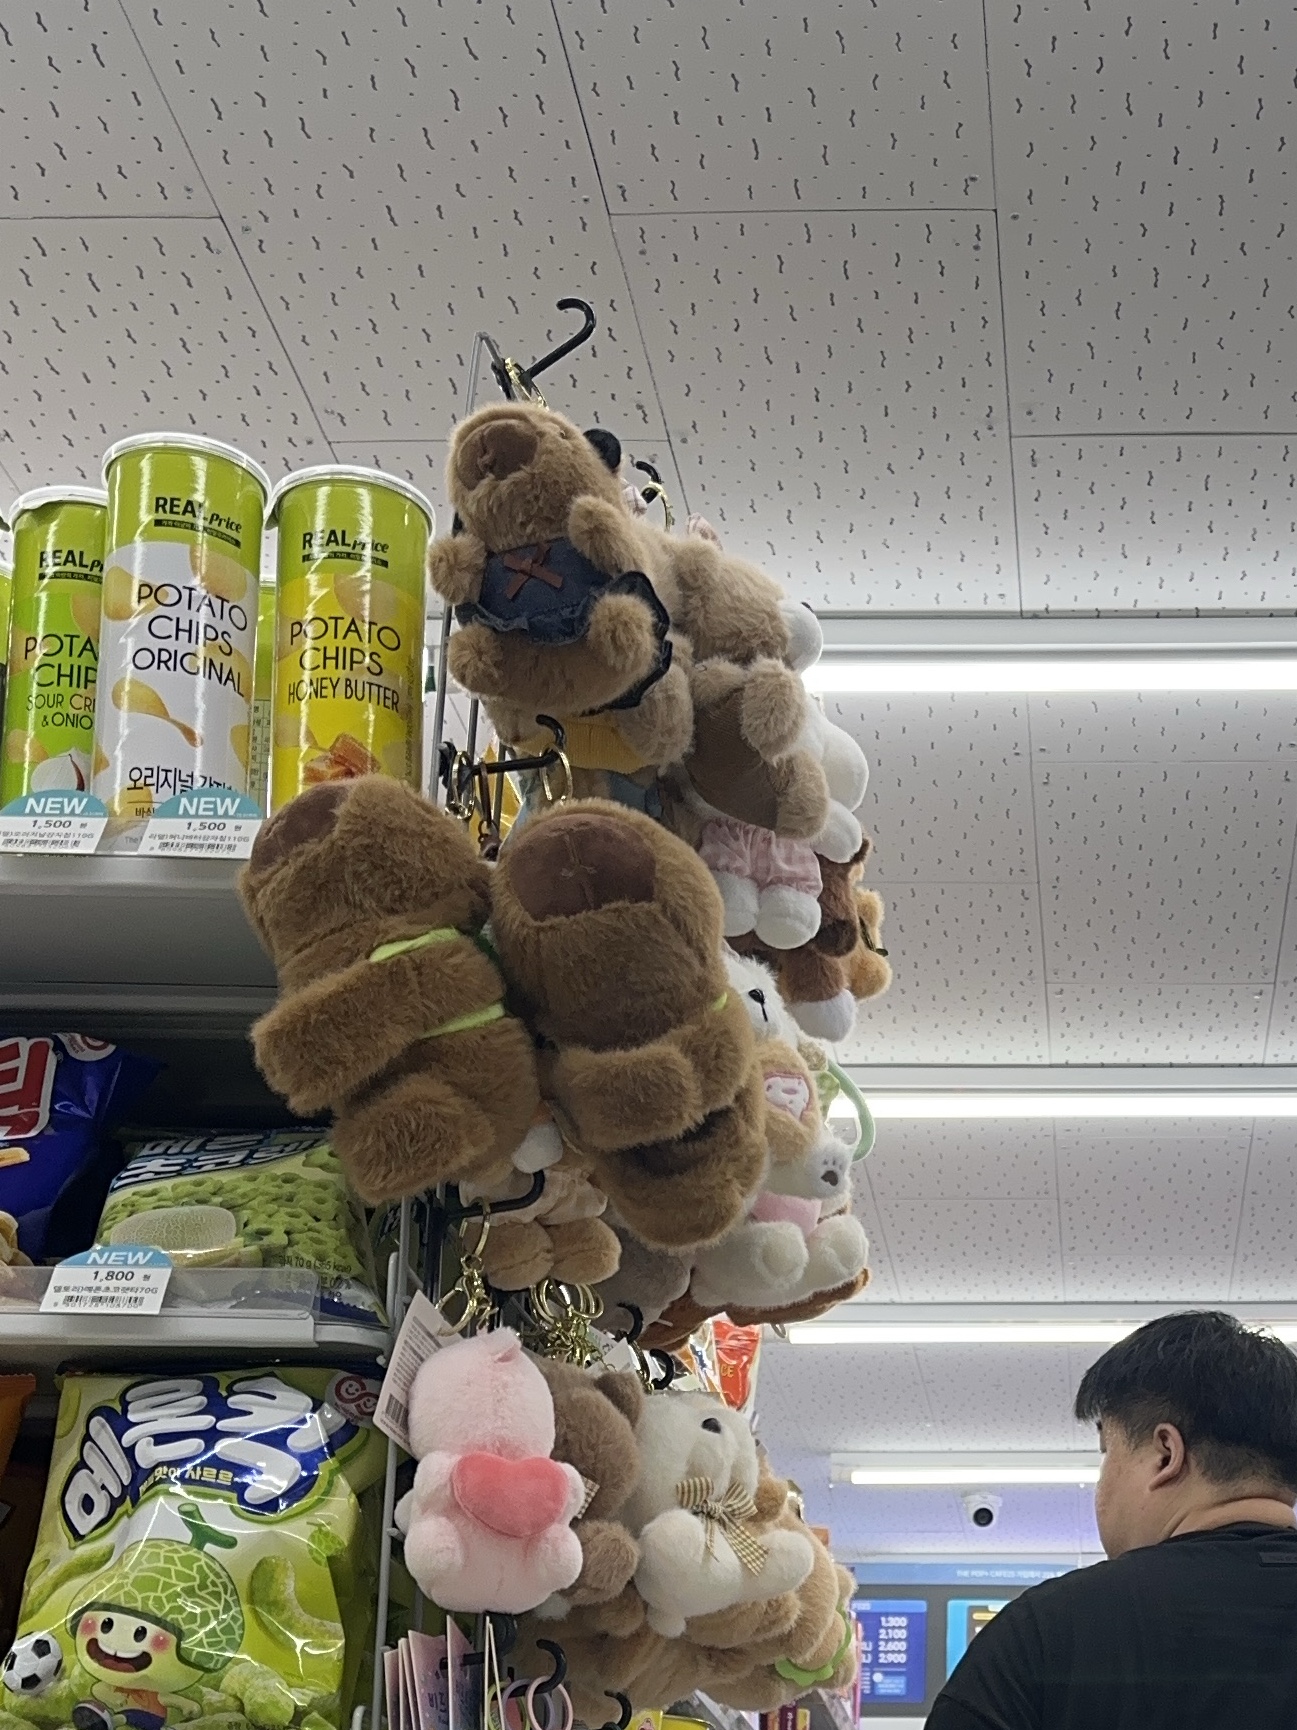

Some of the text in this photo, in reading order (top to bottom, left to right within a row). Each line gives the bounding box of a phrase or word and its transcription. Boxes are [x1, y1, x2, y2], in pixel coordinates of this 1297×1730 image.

[39, 549, 90, 570] REAL
[137, 583, 249, 632] POTATO
[147, 614, 234, 658] CHIPS
[290, 616, 402, 652] POTATO
[24, 633, 98, 661] POTA
[131, 646, 245, 699] ORIGINAL
[299, 646, 384, 677] CHIPS
[34, 662, 98, 688] CHIP
[27, 693, 64, 713] SOUR
[288, 677, 401, 713] HONEY BUTTER
[41, 713, 93, 730] & ONIO
[127, 764, 195, 796] 오리지널
[24, 797, 87, 815] NEW
[178, 796, 241, 816] NEW
[31, 819, 72, 830] 1,500
[186, 822, 226, 832] 1,500
[87, 1252, 152, 1266] NEW
[93, 1270, 135, 1282] 1,800
